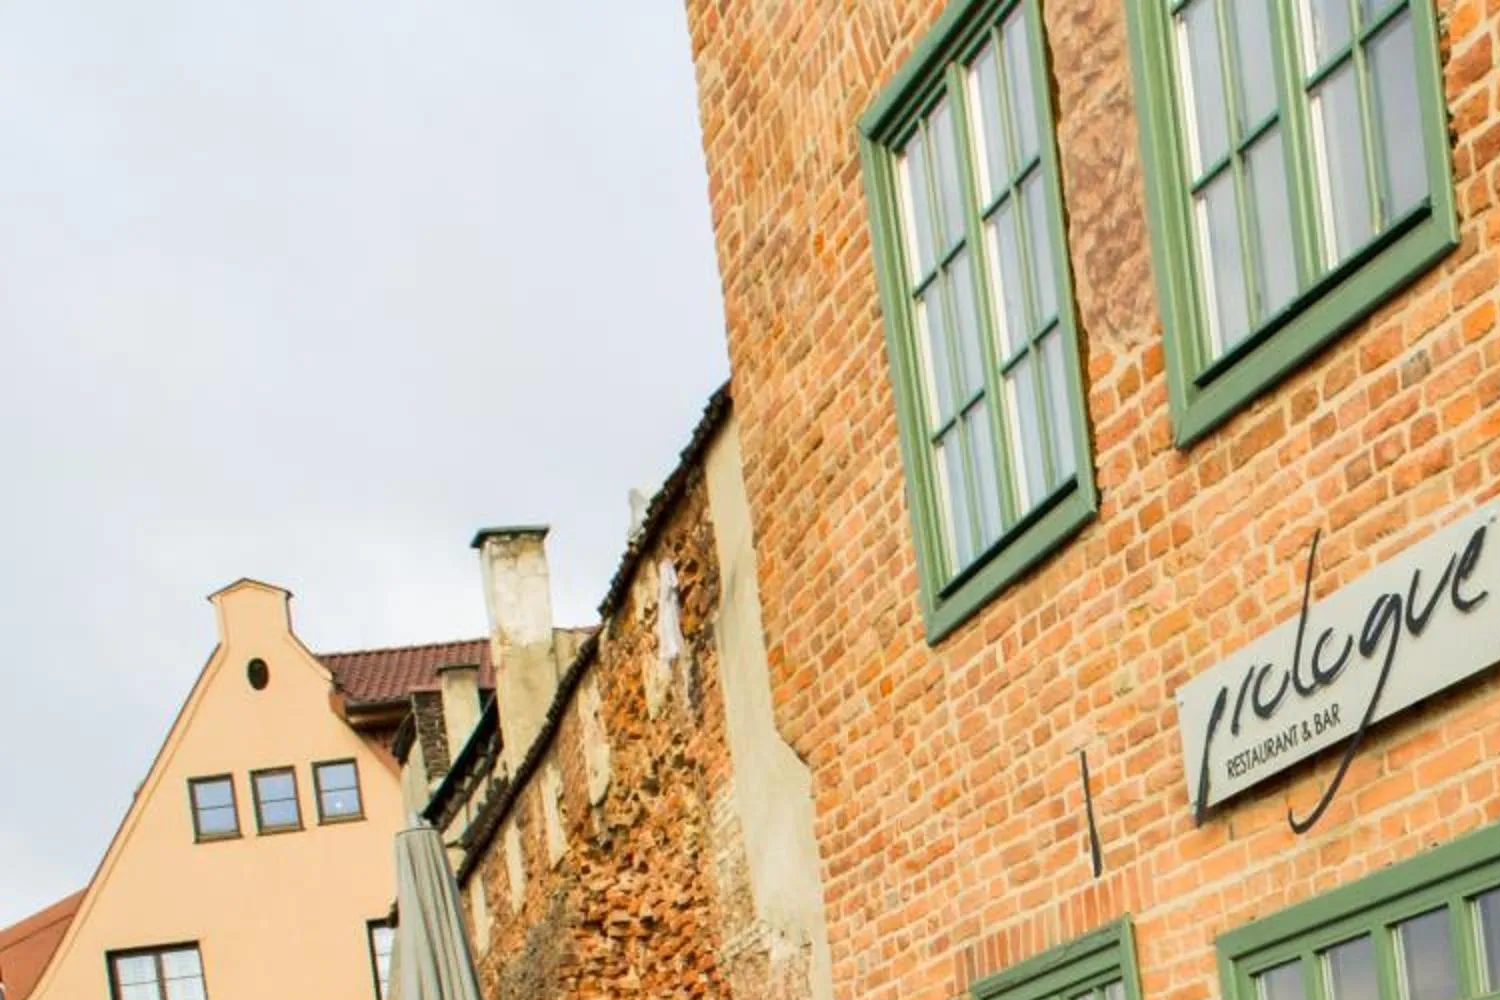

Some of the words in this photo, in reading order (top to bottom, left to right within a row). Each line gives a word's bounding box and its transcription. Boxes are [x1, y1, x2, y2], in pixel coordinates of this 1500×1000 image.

[1226, 724, 1298, 779] RESTAURANT
[1302, 720, 1312, 742] &
[1313, 703, 1341, 735] BAR
